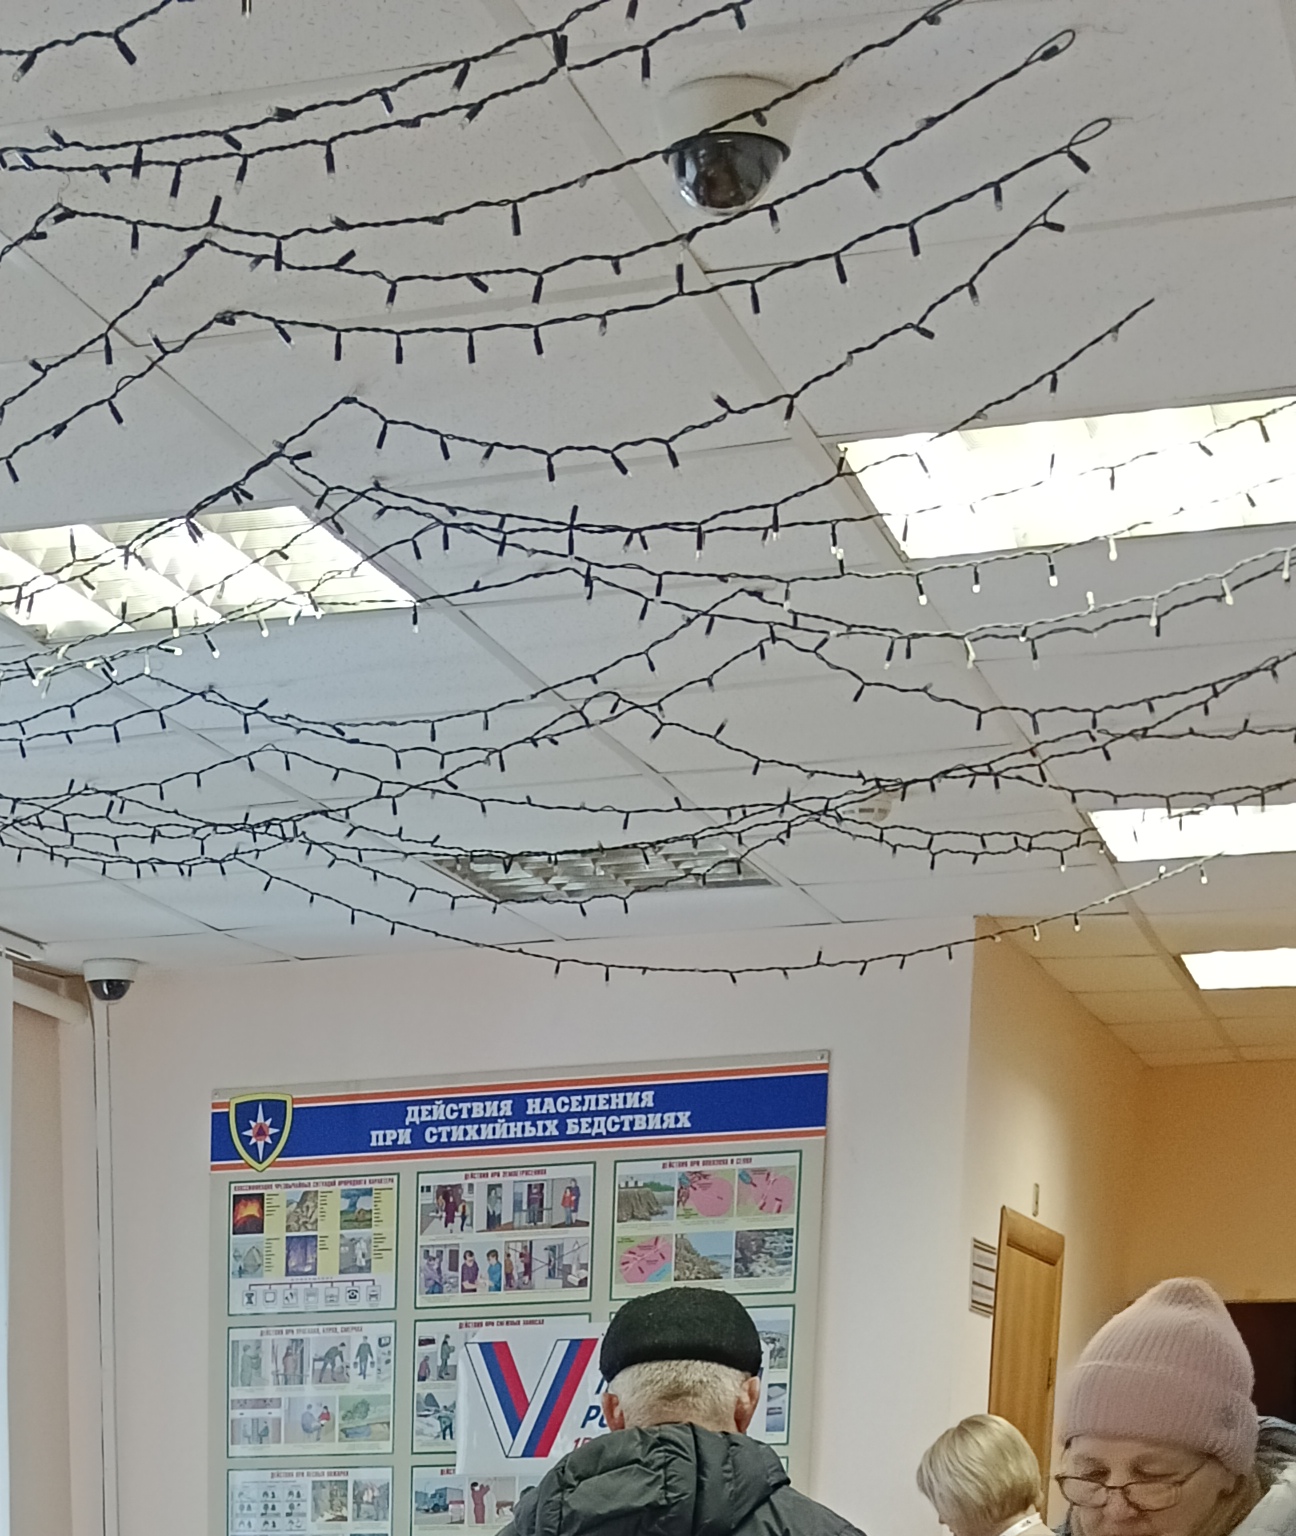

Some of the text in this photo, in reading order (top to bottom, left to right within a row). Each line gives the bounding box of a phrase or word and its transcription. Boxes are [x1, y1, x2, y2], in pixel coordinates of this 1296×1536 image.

[405, 1090, 655, 1126] ДЕЙСТВИЯ НАСЕЛЕНИЯ
[369, 1111, 692, 1147] ПРИ СТИХИЙНЫХ БЕДСТВИЯХ
